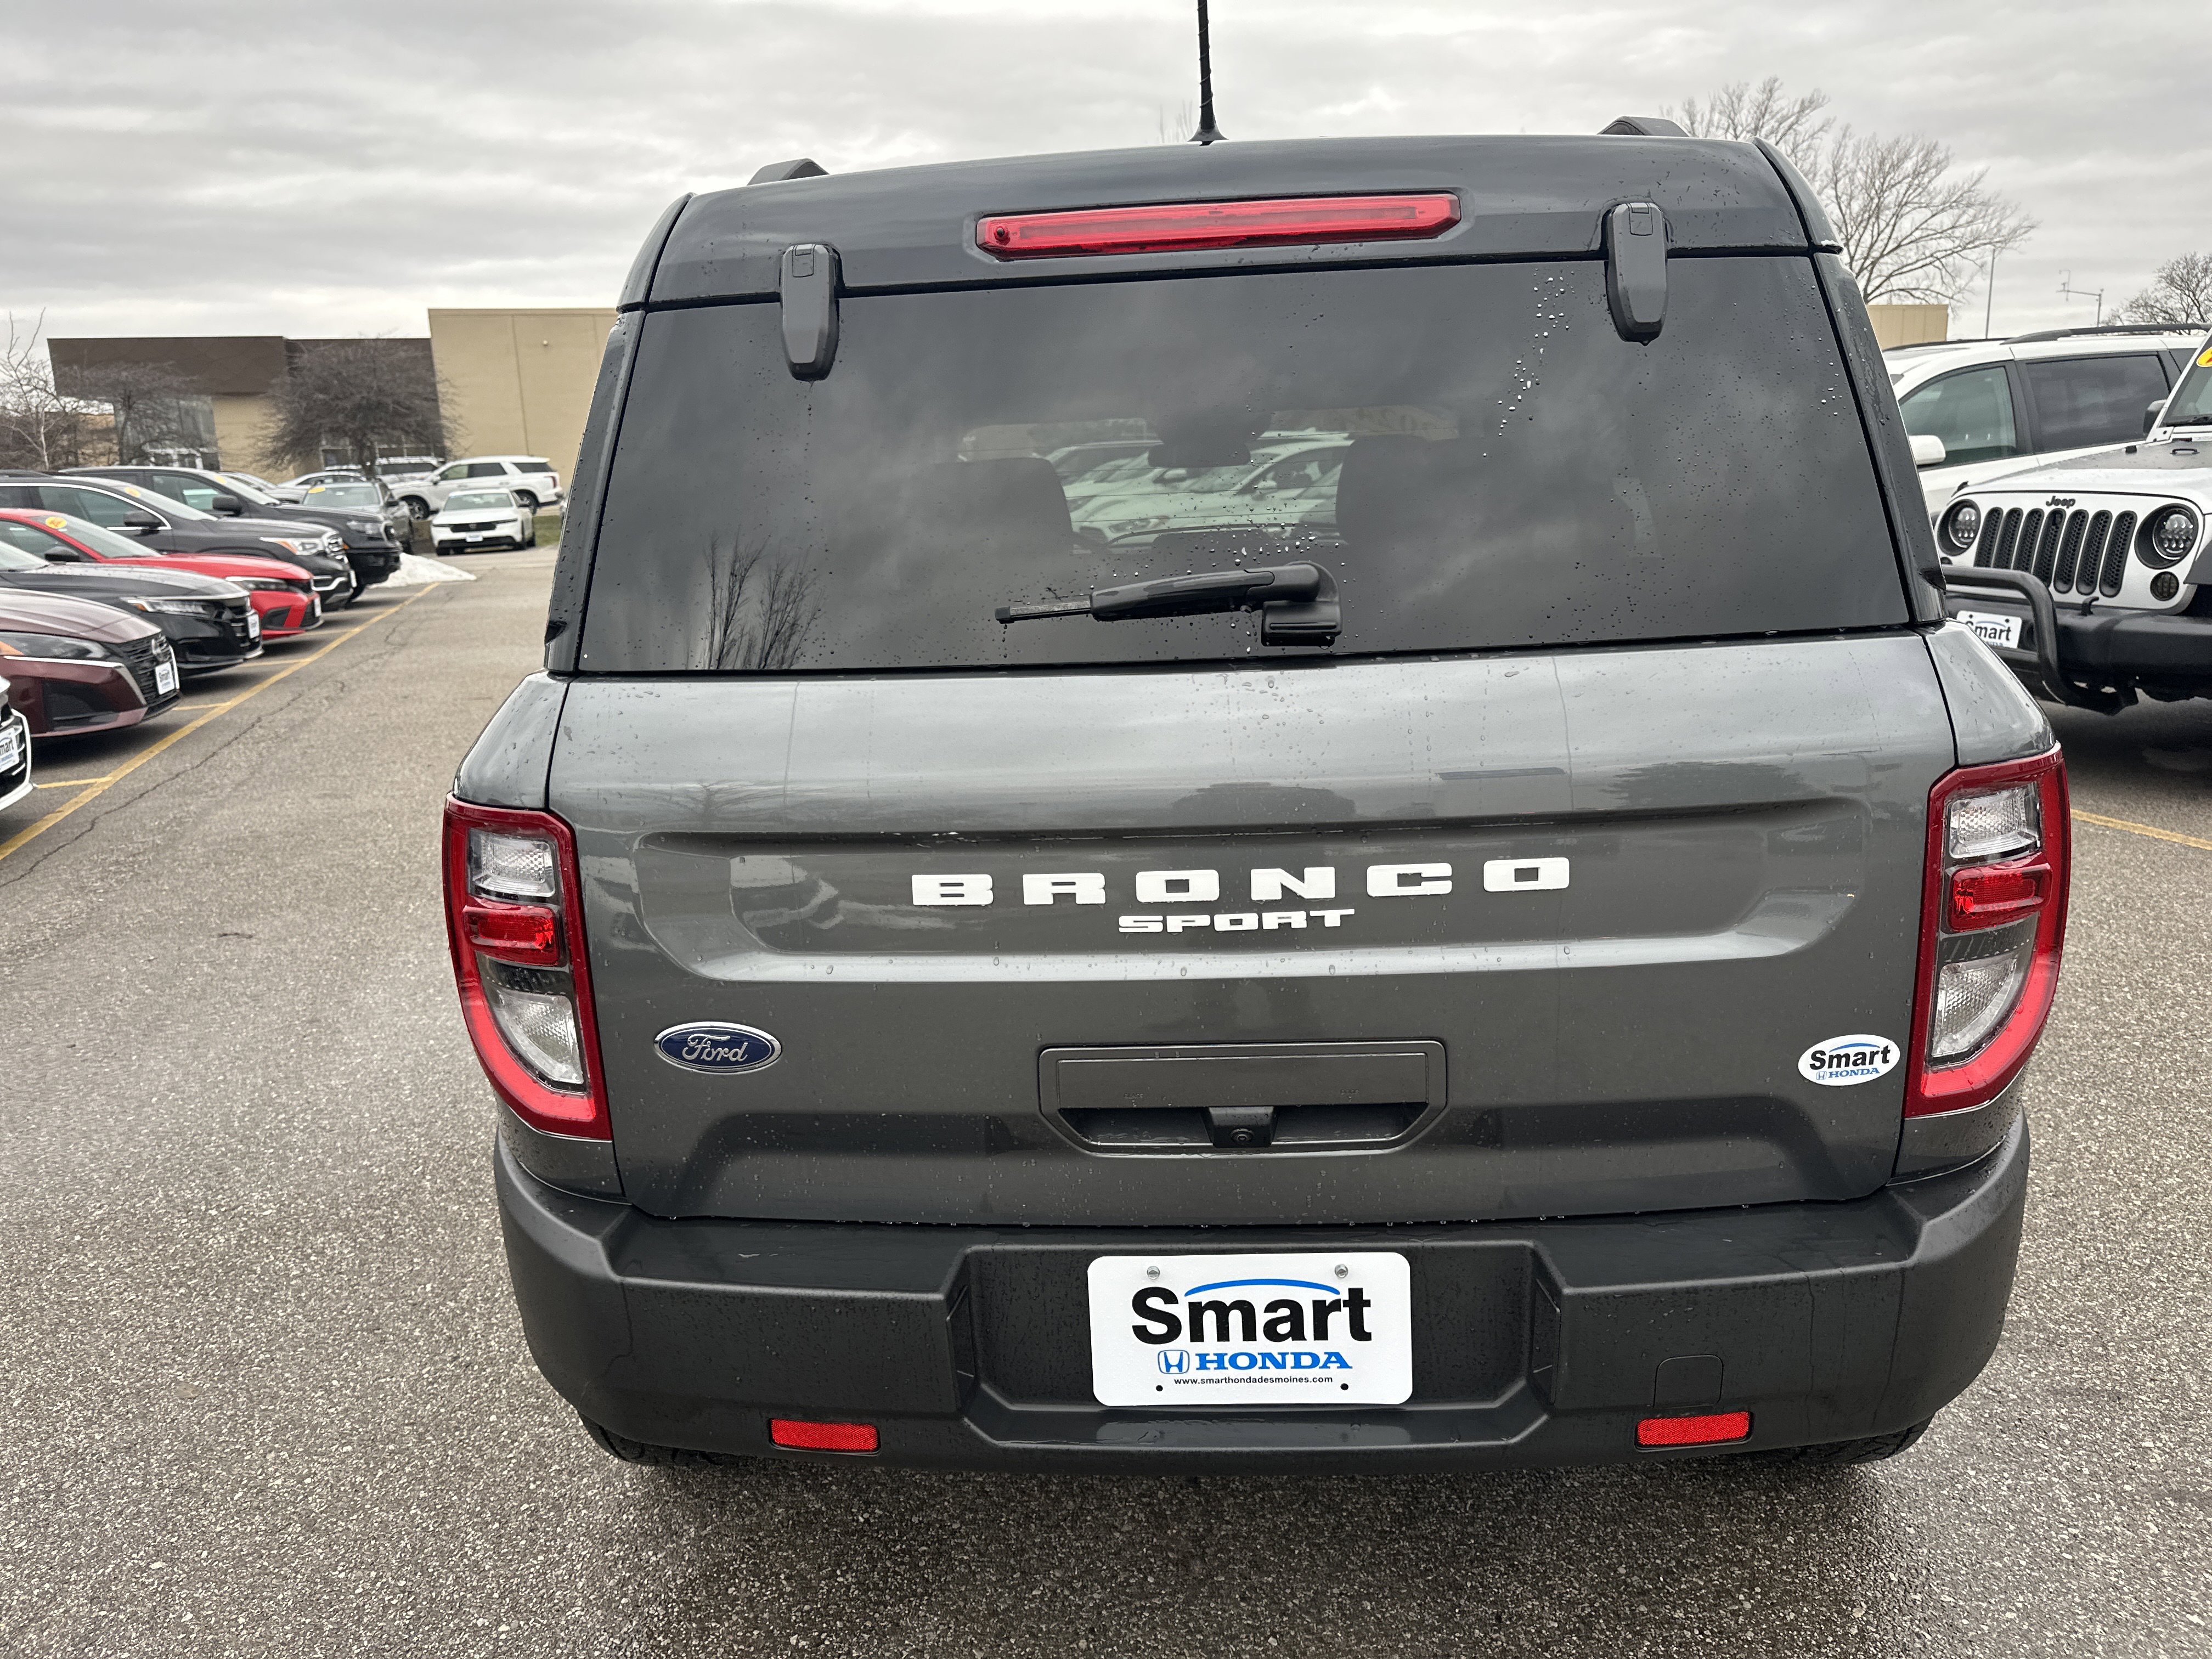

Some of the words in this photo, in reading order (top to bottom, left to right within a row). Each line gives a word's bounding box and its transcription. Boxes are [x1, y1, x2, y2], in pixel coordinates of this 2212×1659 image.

[2045, 495, 2076, 509] Jeep
[0, 737, 14, 756] mart
[911, 856, 1570, 906] BRONCO
[1119, 908, 1355, 933] SPORT
[682, 1033, 749, 1062] Ford
[1809, 1045, 1891, 1070] Smart
[1828, 1067, 1880, 1079] HONDA
[1131, 1286, 1372, 1345] Smart
[1195, 1351, 1353, 1370] HONDA
[1174, 1375, 1333, 1385] www.smarthondadesmoines.com
